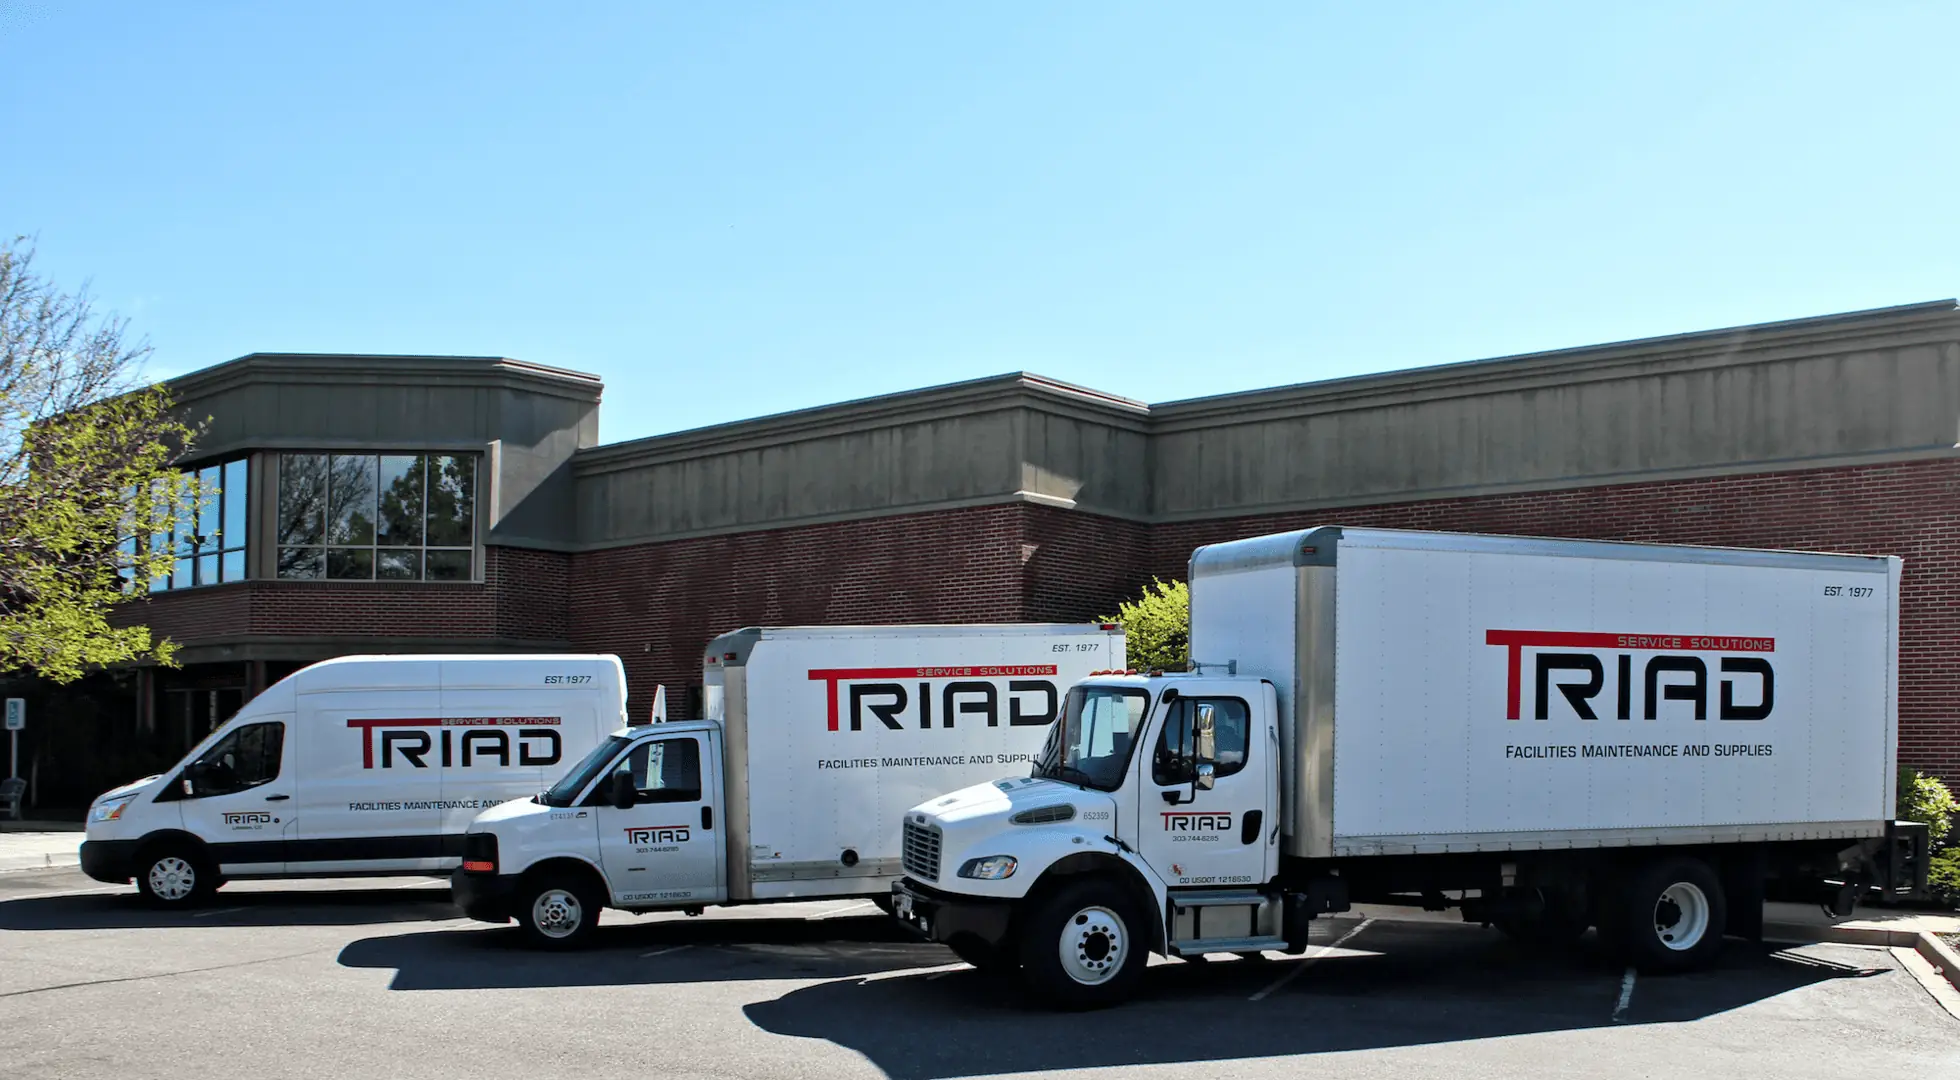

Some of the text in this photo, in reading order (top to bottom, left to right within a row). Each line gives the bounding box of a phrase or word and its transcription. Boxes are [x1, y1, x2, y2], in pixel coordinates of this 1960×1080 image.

[1824, 586, 1874, 598] EST. 1977
[1052, 643, 1099, 653] EST. 1977
[1617, 635, 1773, 651] SERVICE SOLUTIONS
[916, 665, 1054, 677] SERVICE SOLUTIONS
[1486, 629, 1775, 720] TRIAD
[566, 675, 592, 685] 1977
[808, 664, 1058, 731] TRIAD
[441, 716, 560, 726] SERVICE SOLUTIONS
[347, 717, 562, 769] TRIAD
[1506, 744, 1774, 759] FACILITIES MAINTENANCE AND SUPPLIES
[818, 759, 878, 769] FACILITIES
[881, 756, 965, 767] MAINTENANCE
[969, 755, 994, 764] AND
[349, 802, 401, 811] FACILITIES
[404, 800, 479, 810] MAINTENANCE
[221, 811, 271, 825] TRIAD
[1160, 812, 1231, 831] TRIAD
[624, 825, 690, 845] TRIAD
